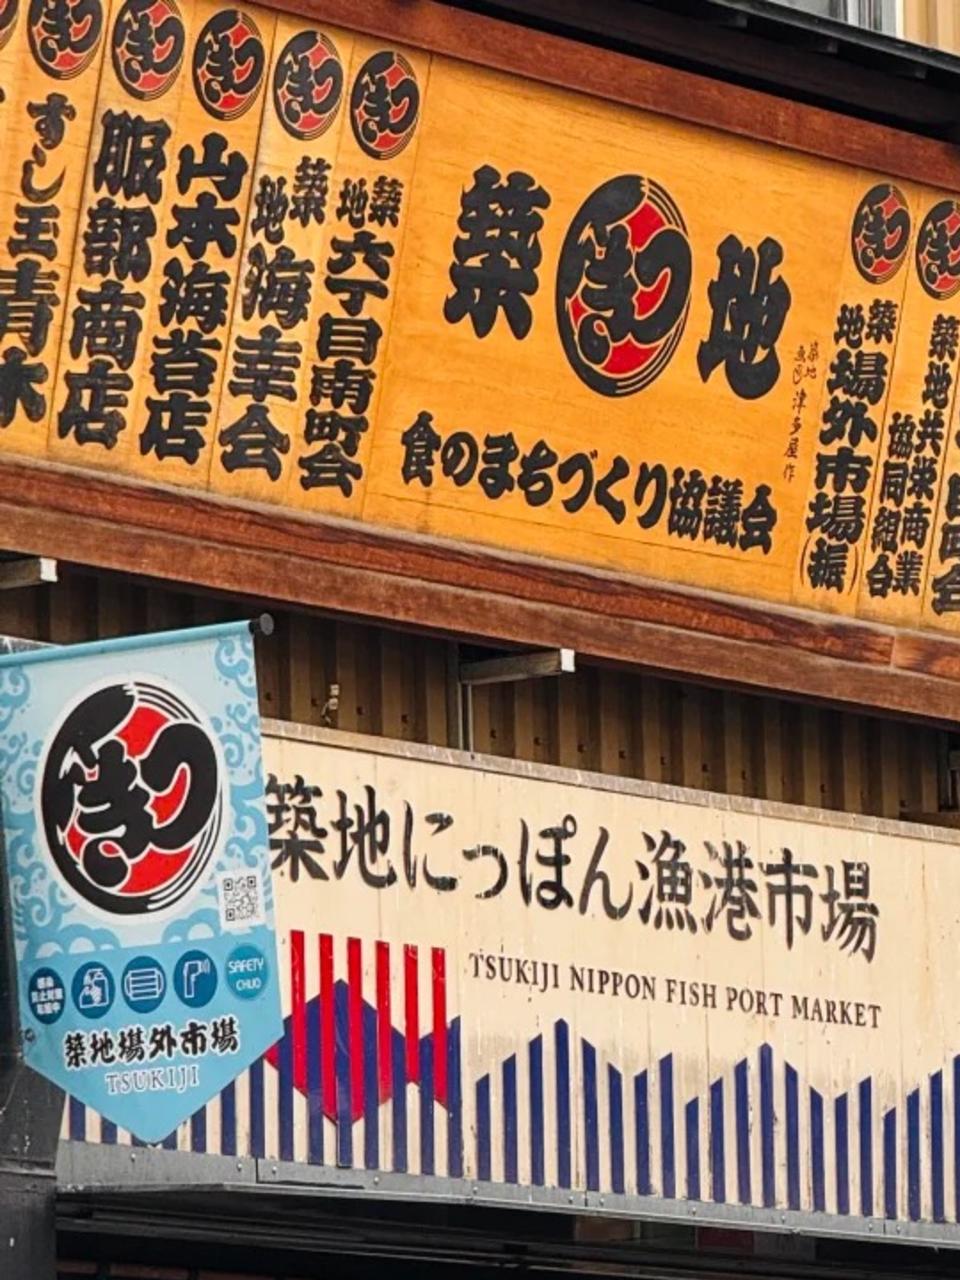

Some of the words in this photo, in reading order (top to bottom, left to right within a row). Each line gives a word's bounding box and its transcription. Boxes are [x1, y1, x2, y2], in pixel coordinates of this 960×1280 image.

[139, 132, 248, 465] 山本海苔店
[400, 409, 778, 556] 食のまちづくり協議会
[264, 772, 881, 964] 築地にっぽん漁港市場
[64, 1016, 240, 1068] 築地場外市場
[468, 952, 561, 992] TSUKIJI
[570, 967, 657, 1001] NIPPON
[666, 978, 718, 1010] FISH
[726, 986, 783, 1018] PORT
[791, 995, 883, 1030] MARKET
[105, 1066, 200, 1094] TSUKIJI
